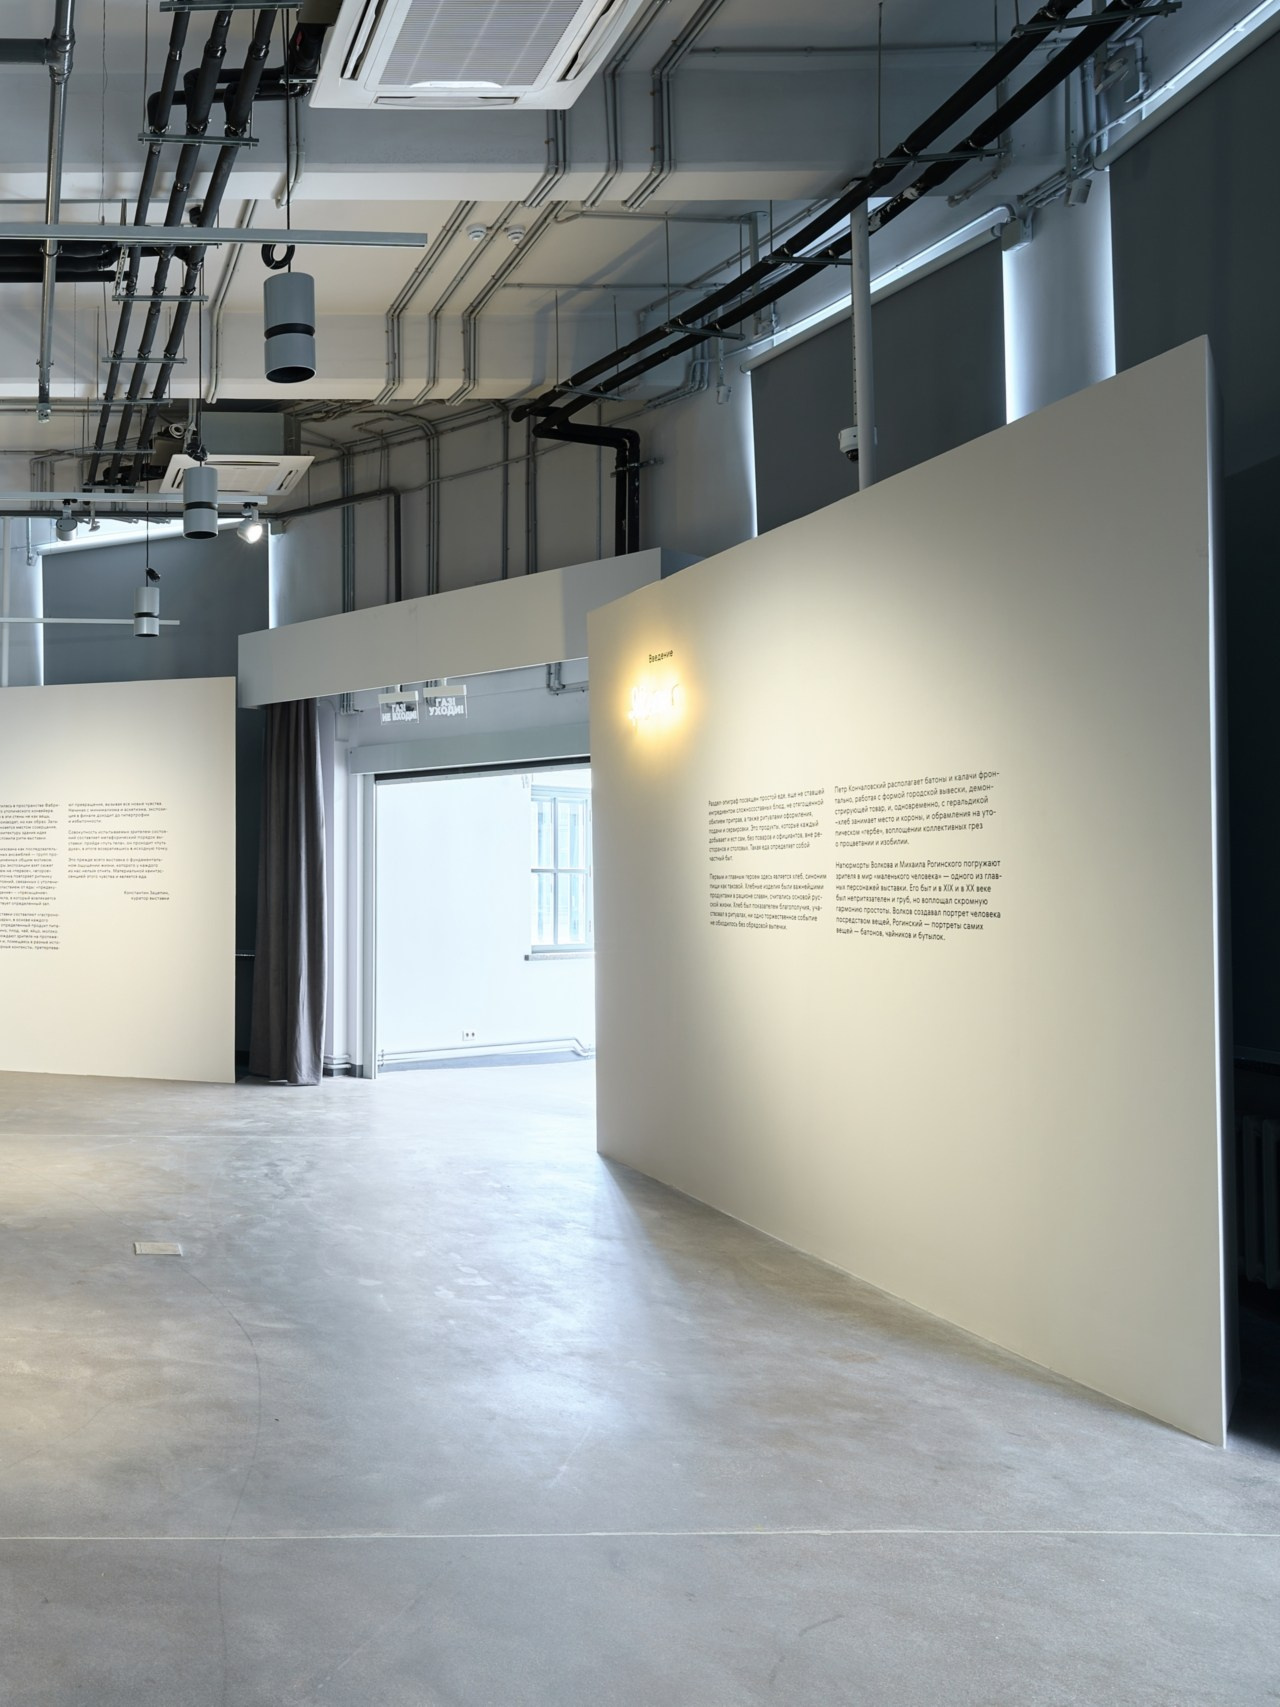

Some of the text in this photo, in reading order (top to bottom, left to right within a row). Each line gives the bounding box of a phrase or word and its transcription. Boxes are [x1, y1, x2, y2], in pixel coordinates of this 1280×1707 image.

[649, 650, 673, 663] Введение
[435, 698, 455, 708] ГАЗ!
[428, 706, 463, 716] УХОДИ!
[382, 713, 391, 722] НЕ
[887, 779, 923, 789] располагает
[924, 775, 947, 784] батоны
[954, 773, 977, 781] калачи
[978, 770, 999, 780] фрон-
[882, 791, 905, 801] формой
[906, 788, 938, 799] городской
[968, 784, 994, 793] демон-
[946, 795, 988, 808] геральдикой
[931, 810, 971, 821] обрамления
[982, 809, 996, 818] уто-
[968, 823, 983, 831] грез
[927, 860, 962, 868] Рогинского
[963, 861, 1000, 869] погружают
[954, 898, 988, 906] скромную
[892, 907, 912, 915] Волков
[943, 910, 969, 918] портрет
[892, 918, 923, 927] Рогинский
[931, 922, 962, 930] портреты
[885, 930, 912, 938] чайников
